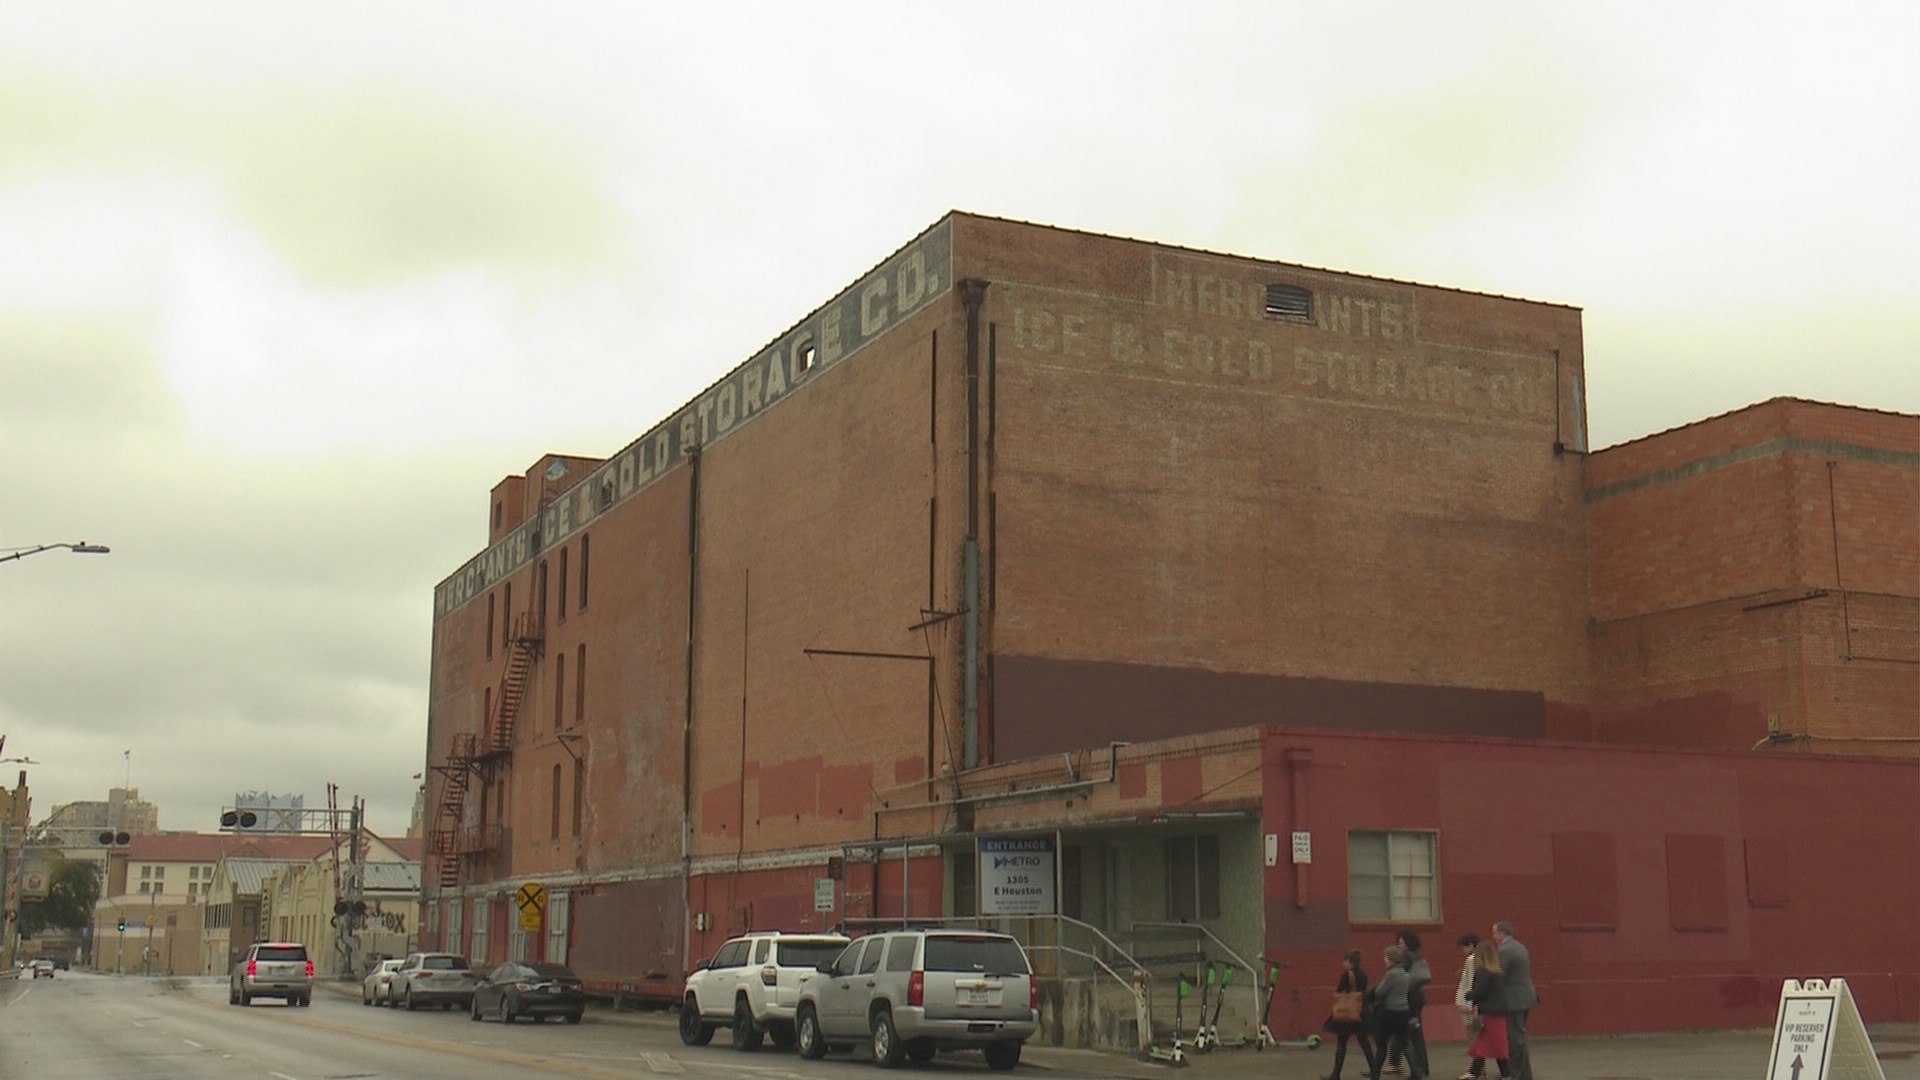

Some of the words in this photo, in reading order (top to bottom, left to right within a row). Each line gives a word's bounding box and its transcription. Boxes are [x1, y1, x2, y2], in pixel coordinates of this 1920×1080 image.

[1165, 269, 1402, 340] MERCANTS
[986, 840, 1047, 850] ENTRANCE
[1007, 875, 1029, 884] 1305
[1002, 886, 1042, 895] Houston
[1785, 1023, 1796, 1033] VIP
[1795, 1023, 1825, 1033] RESERVED
[1790, 1033, 1816, 1043] PARKING
[1793, 1044, 1809, 1053] ONLY
